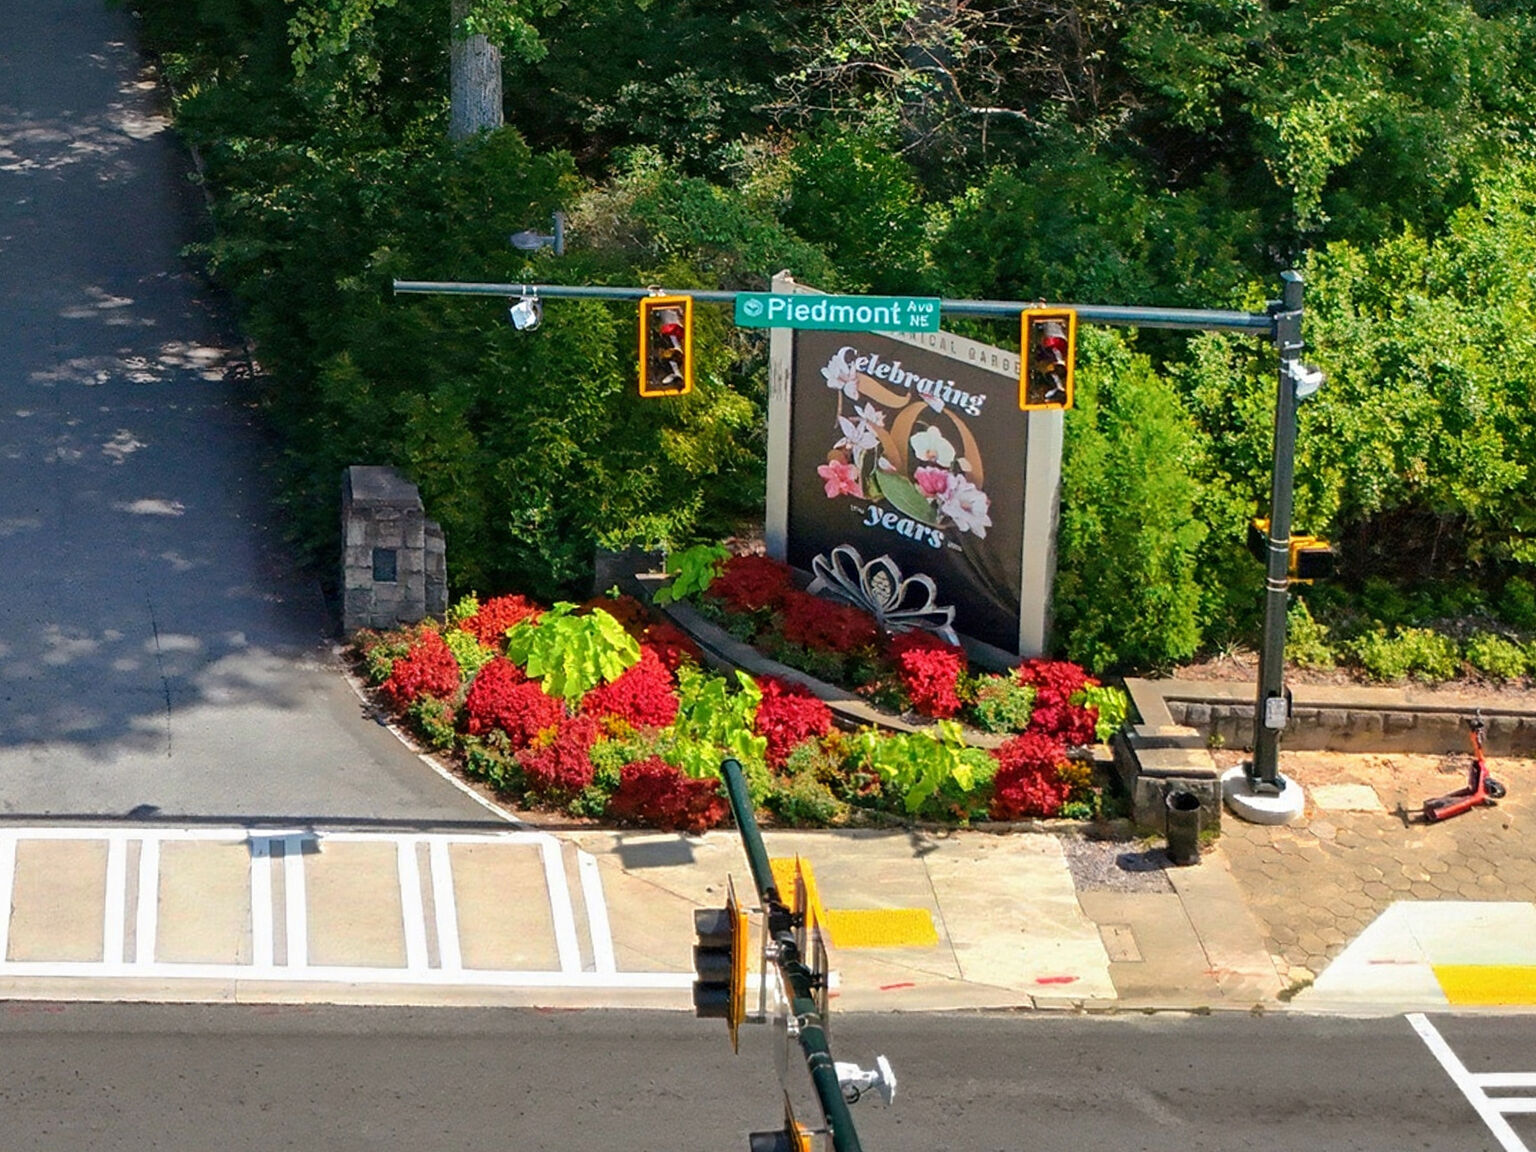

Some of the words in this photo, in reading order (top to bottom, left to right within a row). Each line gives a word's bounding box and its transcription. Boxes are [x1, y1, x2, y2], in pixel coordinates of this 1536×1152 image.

[767, 298, 902, 325] Piedmont
[909, 314, 930, 327] NE
[968, 347, 1021, 374] GARDE
[835, 346, 986, 417] Celebrating
[863, 504, 944, 548] years
